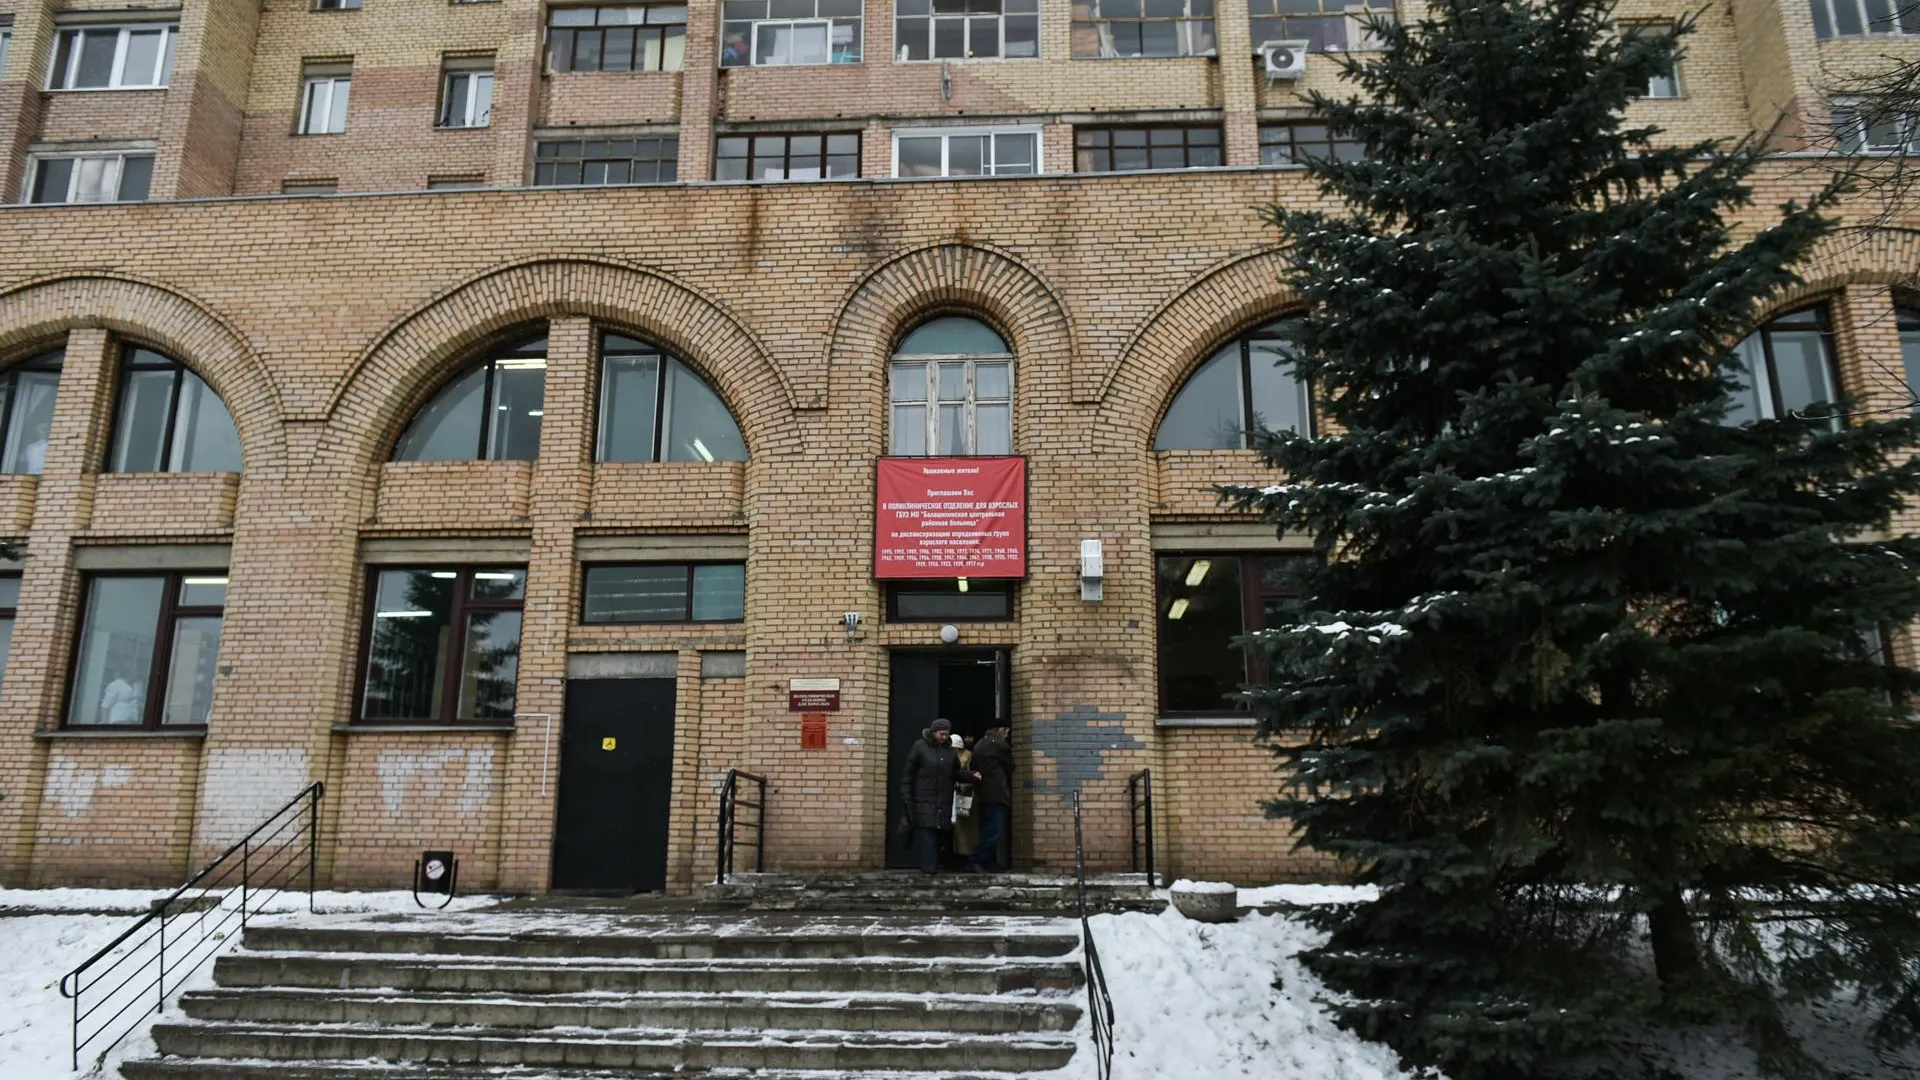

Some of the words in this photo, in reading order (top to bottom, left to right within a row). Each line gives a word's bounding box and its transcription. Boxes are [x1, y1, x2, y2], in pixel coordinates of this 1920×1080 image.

[927, 489, 962, 497] Приглашаем
[975, 502, 987, 510] ДЛЯ
[969, 511, 1005, 519] центральная
